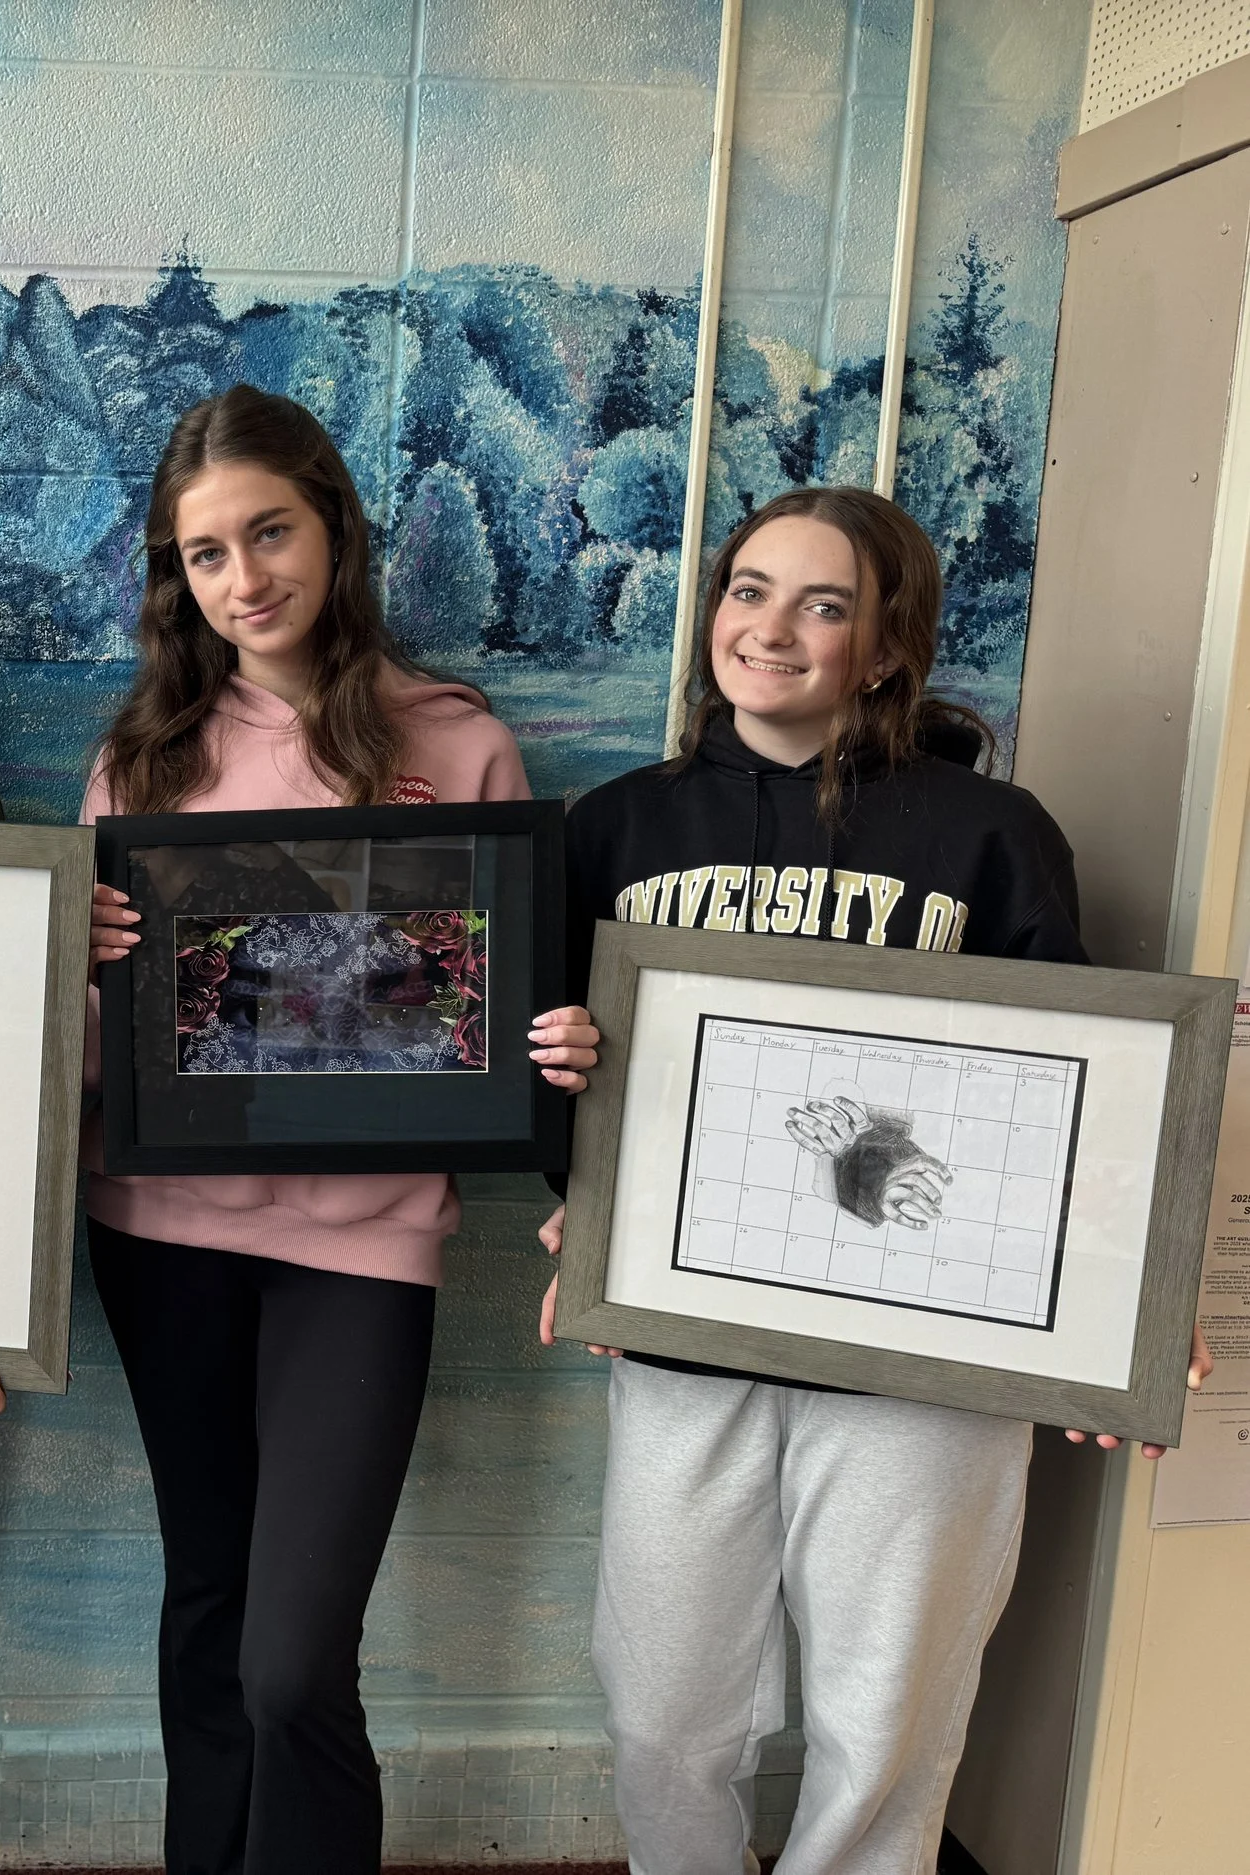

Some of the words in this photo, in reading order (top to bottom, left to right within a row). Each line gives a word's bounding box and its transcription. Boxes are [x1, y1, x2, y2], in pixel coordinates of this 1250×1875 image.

[615, 865, 905, 946] UNIVERSITY
[714, 1028, 745, 1043] Sunday
[763, 1036, 796, 1049] Monday
[815, 1043, 845, 1055] Tuesday
[915, 1054, 951, 1068] Thursday
[966, 1061, 993, 1073] Friday
[1020, 1079, 1027, 1087] 3
[707, 1085, 714, 1094] 4
[756, 1092, 762, 1100] 5
[936, 1259, 948, 1267] 30
